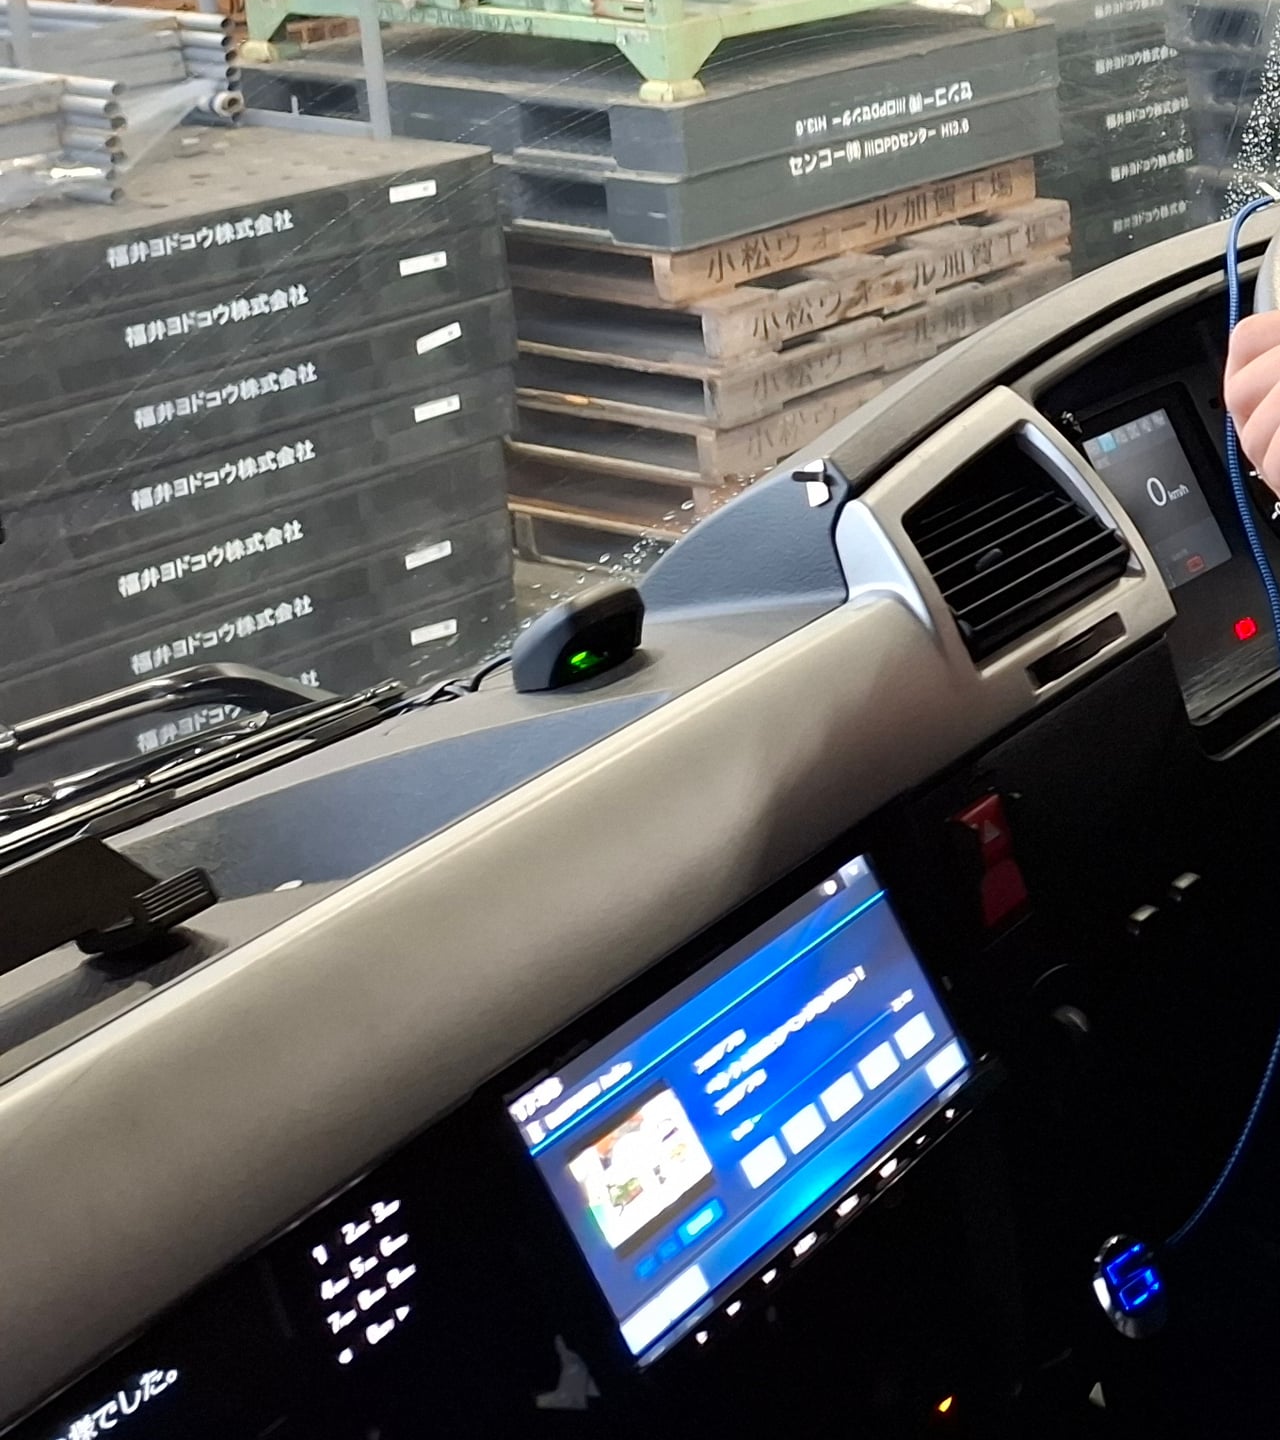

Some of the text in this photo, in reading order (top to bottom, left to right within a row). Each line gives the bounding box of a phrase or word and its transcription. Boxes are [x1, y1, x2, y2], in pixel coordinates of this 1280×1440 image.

[106, 209, 294, 269] 福井ヨドコウ株式会社
[125, 283, 309, 348] 福井ヨドコウ株式会社
[134, 361, 318, 430] 福井ヨドコウ株式会社
[131, 439, 316, 511] 福井ヨドコウ株式会社
[1146, 477, 1168, 506] 0
[118, 520, 304, 598] 福井ヨドコウ株式会社
[130, 595, 314, 675] 福井ヨドコウ株式会社
[56, 1369, 178, 1440] 様でした。
